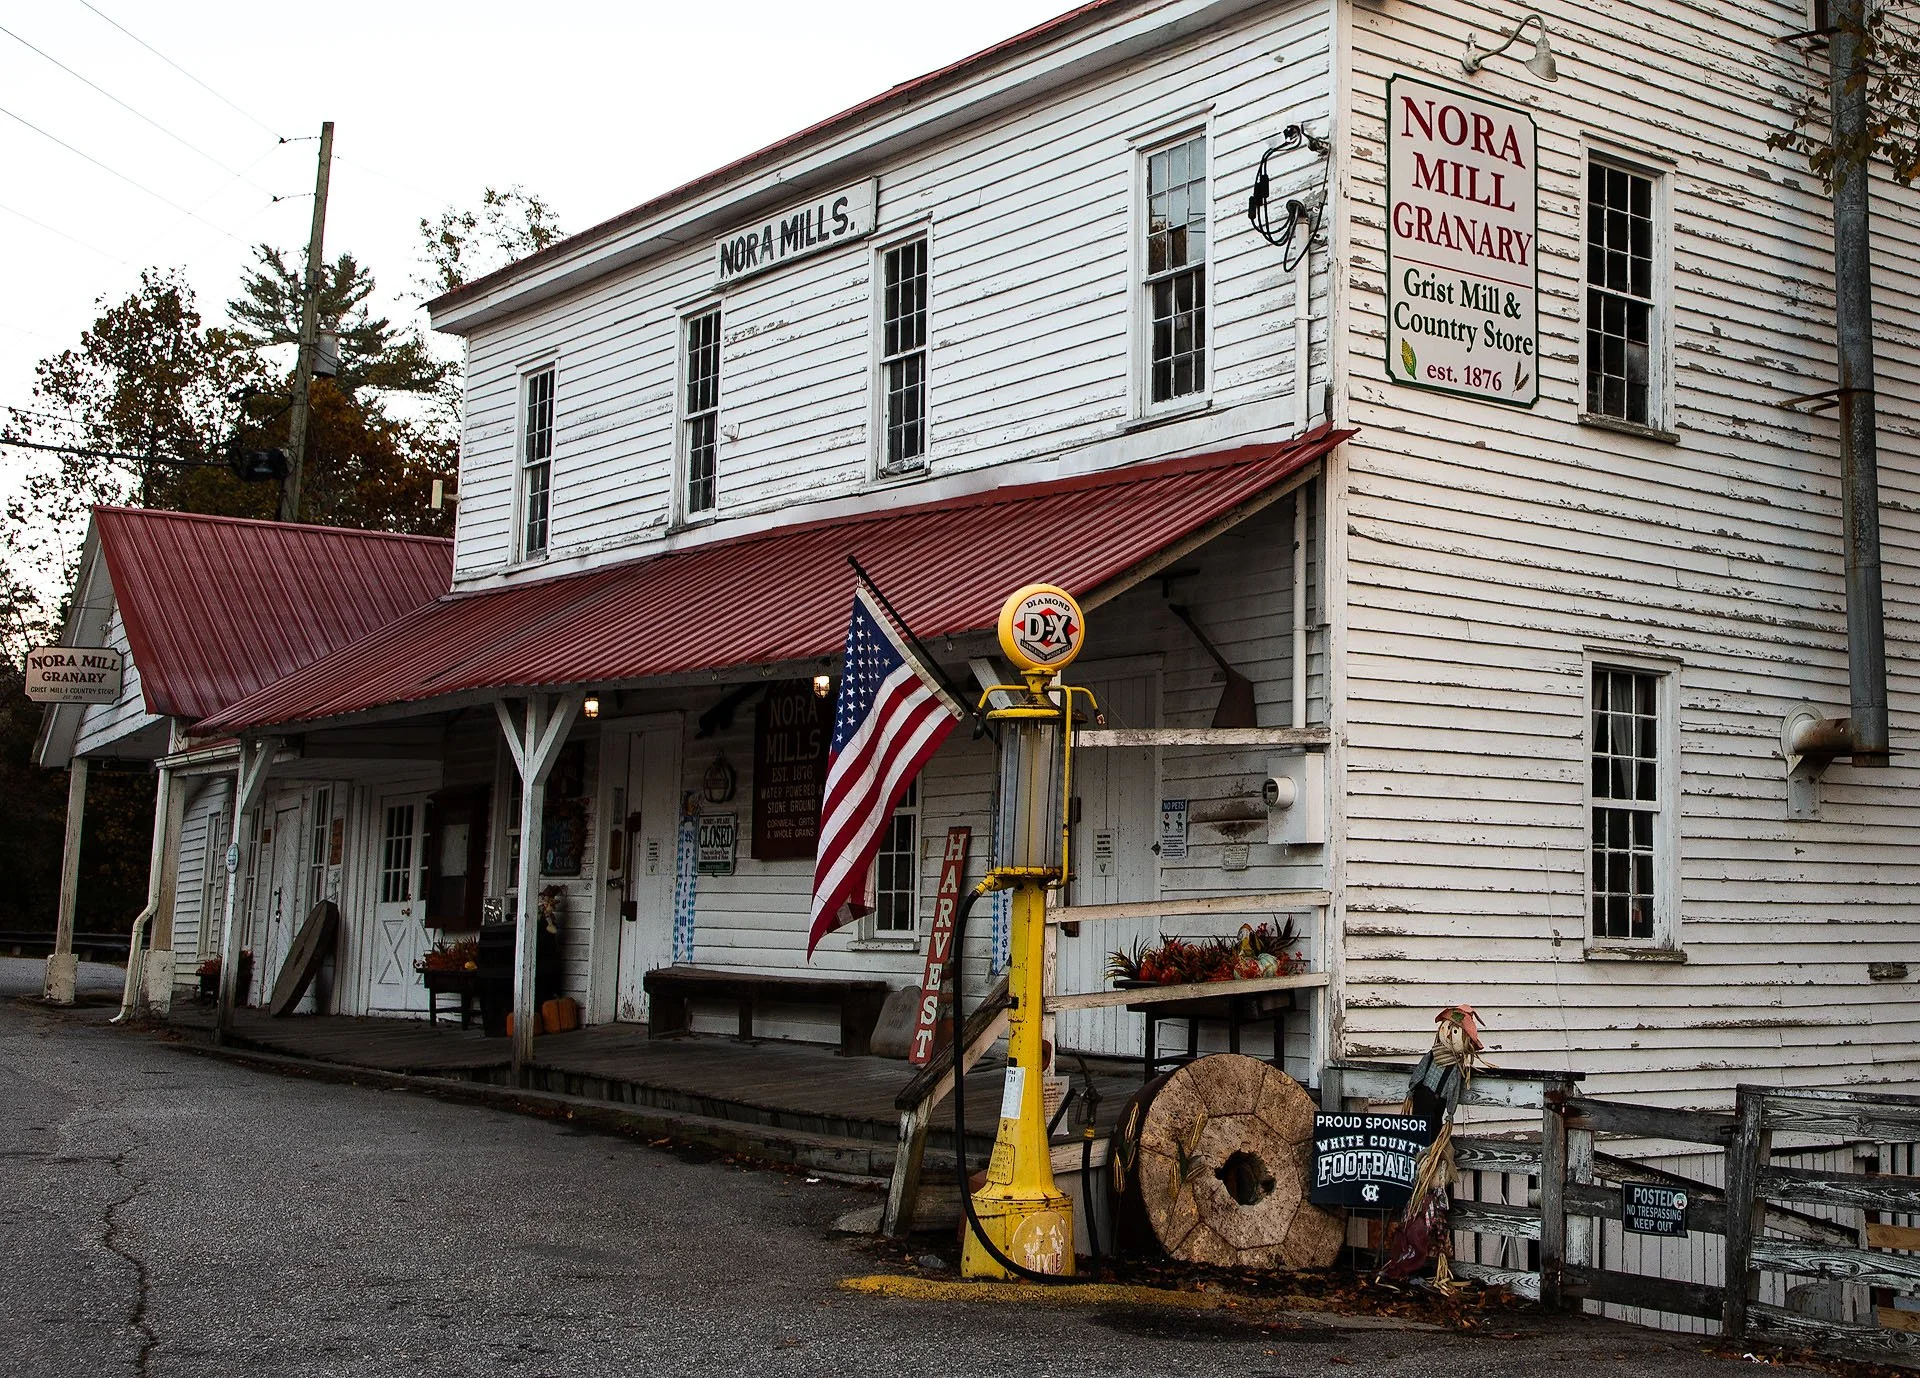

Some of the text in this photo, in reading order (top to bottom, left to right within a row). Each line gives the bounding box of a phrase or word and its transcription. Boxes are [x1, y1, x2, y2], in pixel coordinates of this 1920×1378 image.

[1400, 96, 1526, 169] NORA
[1411, 151, 1516, 212] MILL
[720, 196, 855, 278] NORA MILLS.
[1393, 202, 1533, 267] GRANARY
[1403, 267, 1522, 320] Grist Mill &
[1393, 301, 1534, 356] Country Store
[1426, 363, 1503, 391] est. 1876
[1026, 598, 1070, 611] DIAMOND
[30, 655, 119, 671] NORA MILL
[42, 672, 106, 683] GRANARY
[70, 687, 97, 695] COUNTRY
[770, 696, 818, 727] NORA
[766, 730, 820, 764] MILLS
[772, 765, 813, 782] EST. 1876
[761, 787, 782, 800] WATER
[786, 785, 815, 797] POWERED
[768, 800, 815, 813] STONE GROUND
[1163, 801, 1185, 810] NO PETS
[699, 825, 734, 849] CLOSED
[773, 828, 792, 838] WHOLE
[916, 833, 967, 1059] HARVEST
[1316, 1116, 1427, 1132] PROUD SPONSOR
[1316, 1135, 1427, 1154] WHITE COUNTY
[1634, 1188, 1674, 1207] POSTED
[1627, 1204, 1681, 1220] NO TRESPASSING
[1634, 1218, 1673, 1231] KEEP OUT
